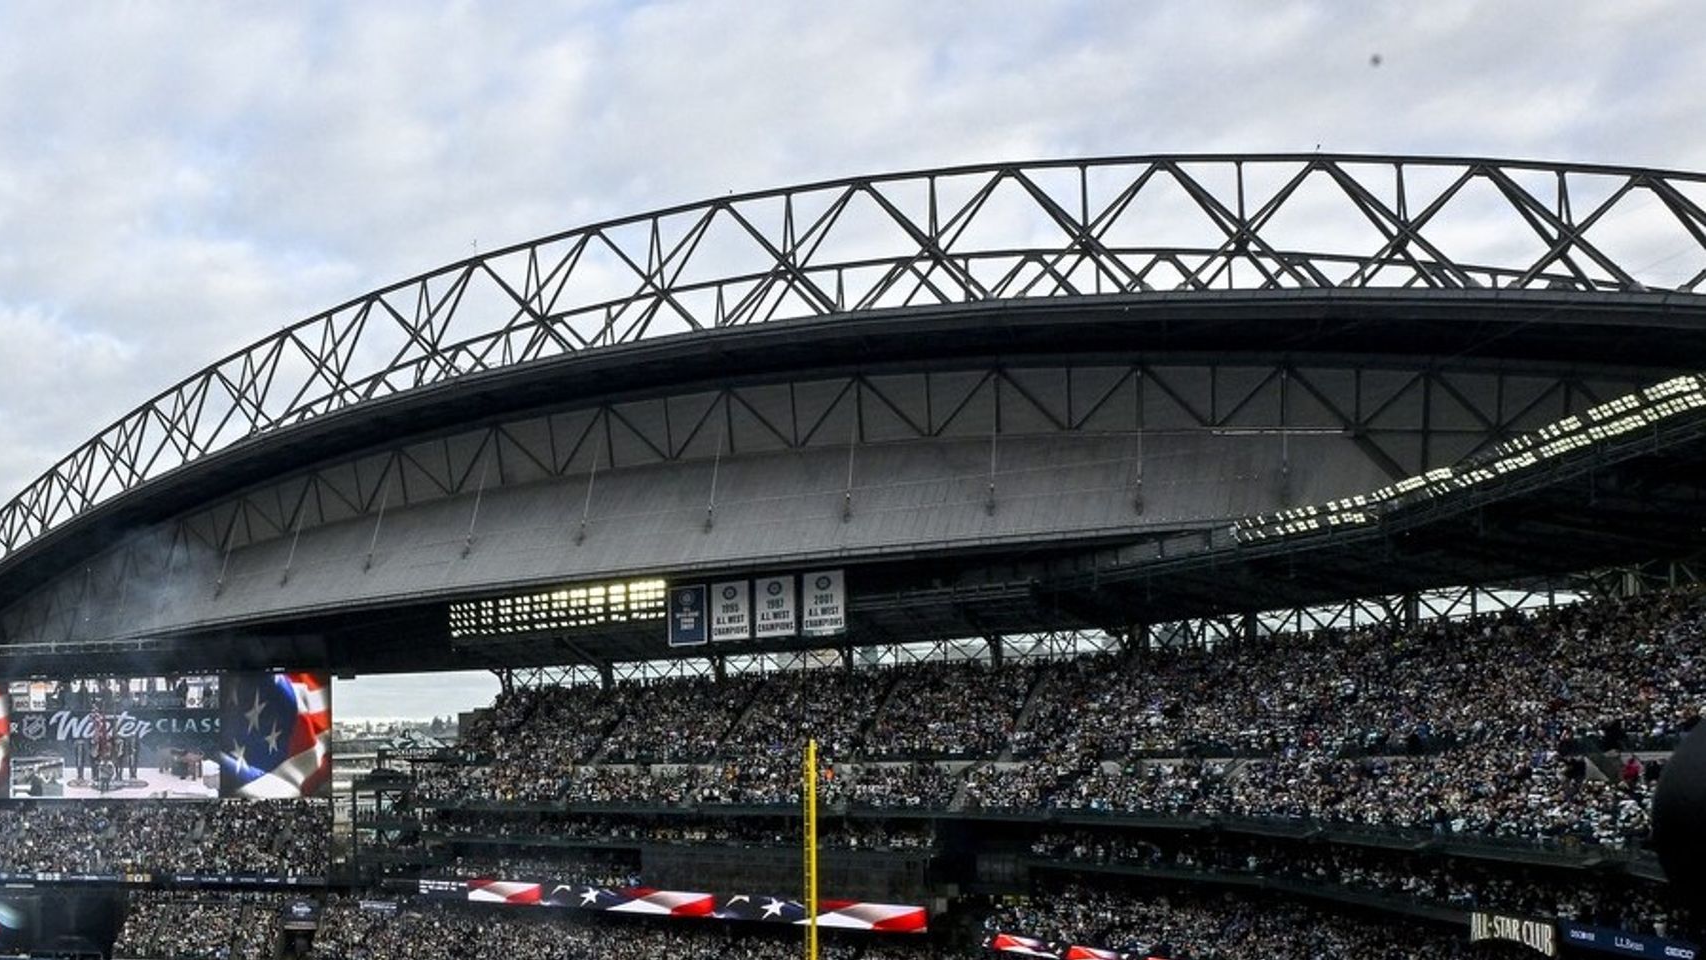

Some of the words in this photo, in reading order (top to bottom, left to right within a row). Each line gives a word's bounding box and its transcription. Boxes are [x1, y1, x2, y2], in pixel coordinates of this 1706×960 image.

[757, 621, 794, 633] CHAMPIONS
[805, 617, 843, 628] CHAMPIONS
[1522, 920, 1554, 957] CLUB
